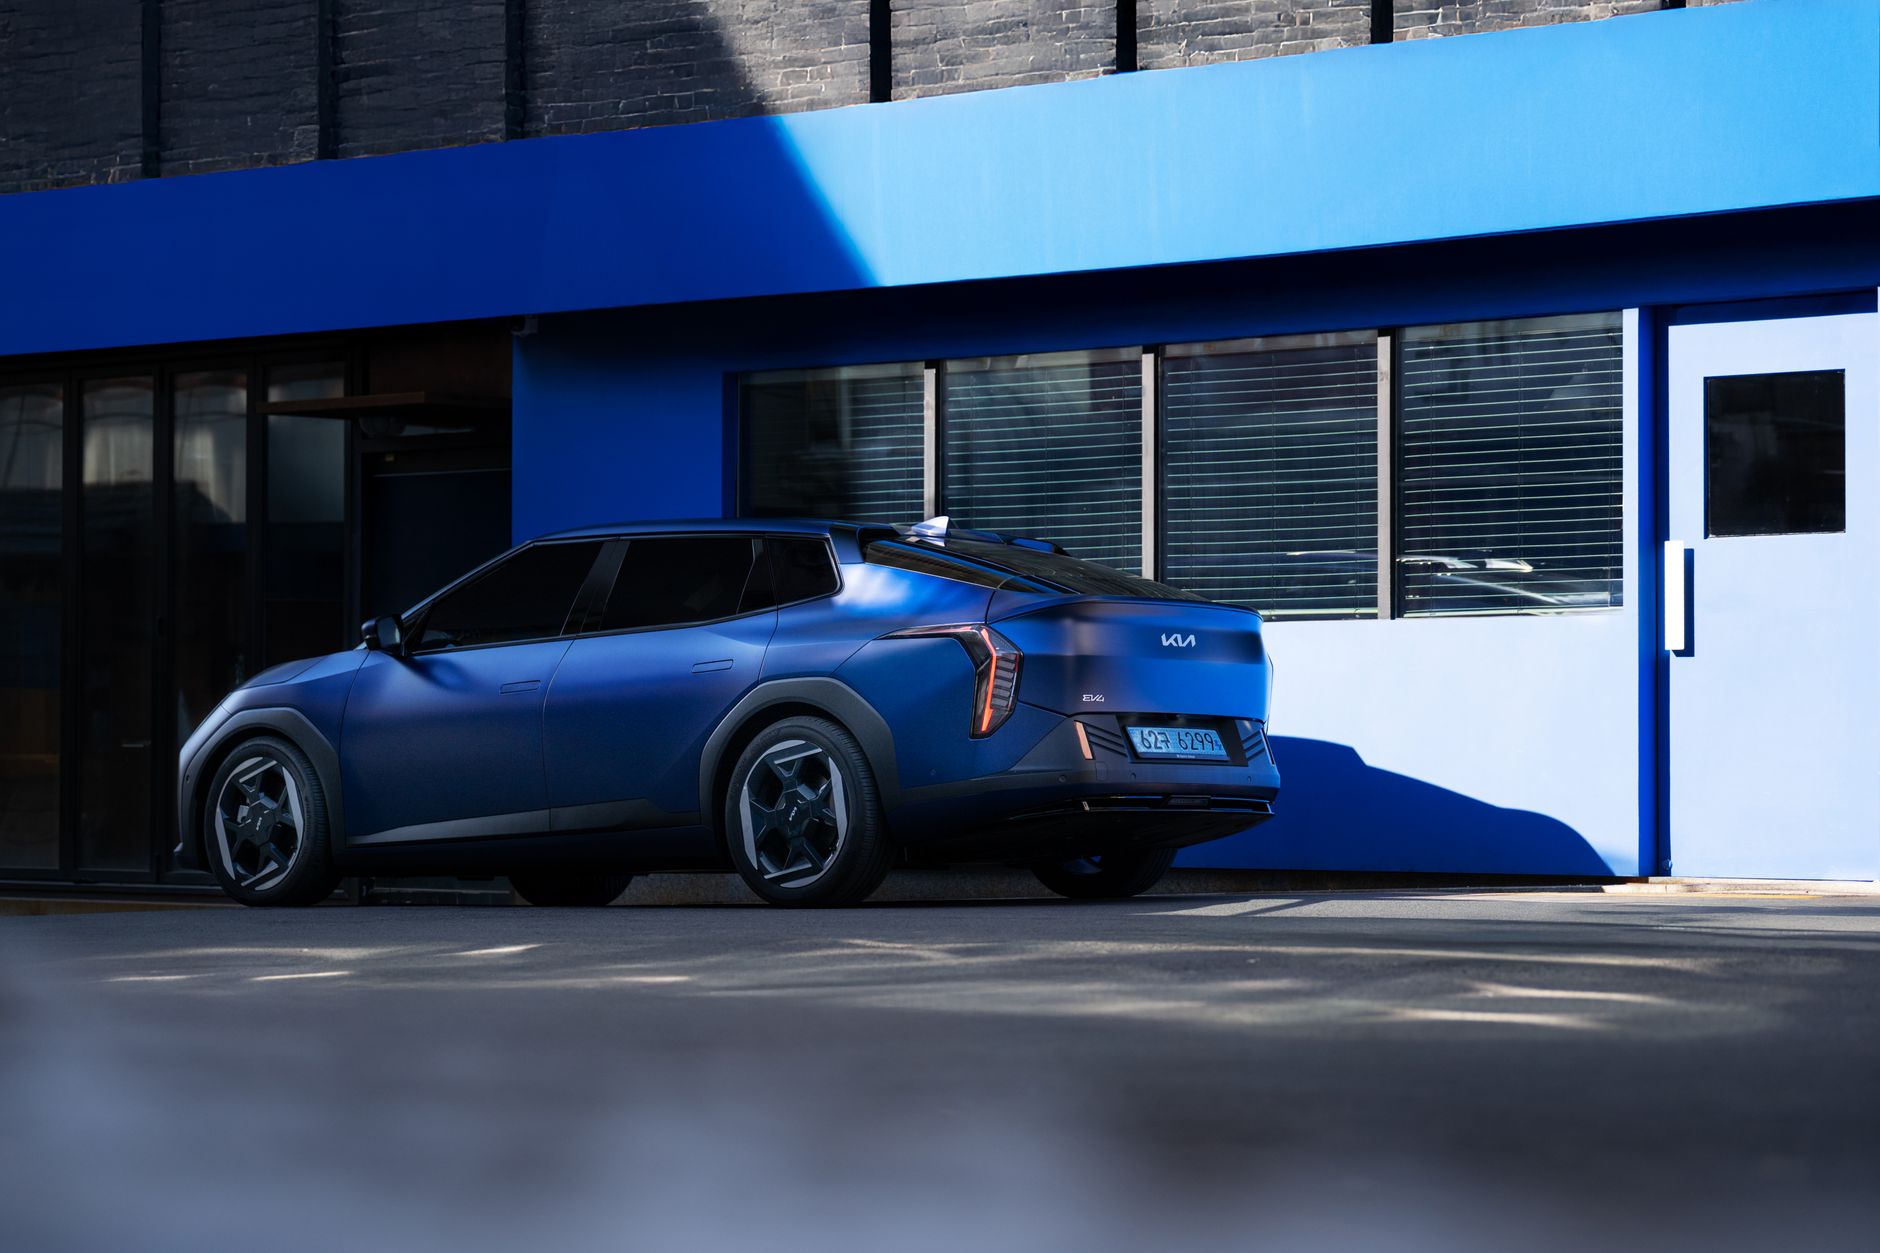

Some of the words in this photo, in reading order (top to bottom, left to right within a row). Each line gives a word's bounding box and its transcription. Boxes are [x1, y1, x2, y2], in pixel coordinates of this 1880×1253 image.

[1161, 633, 1196, 648] KIA
[1082, 694, 1105, 702] EV4
[1177, 731, 1214, 751] 6299
